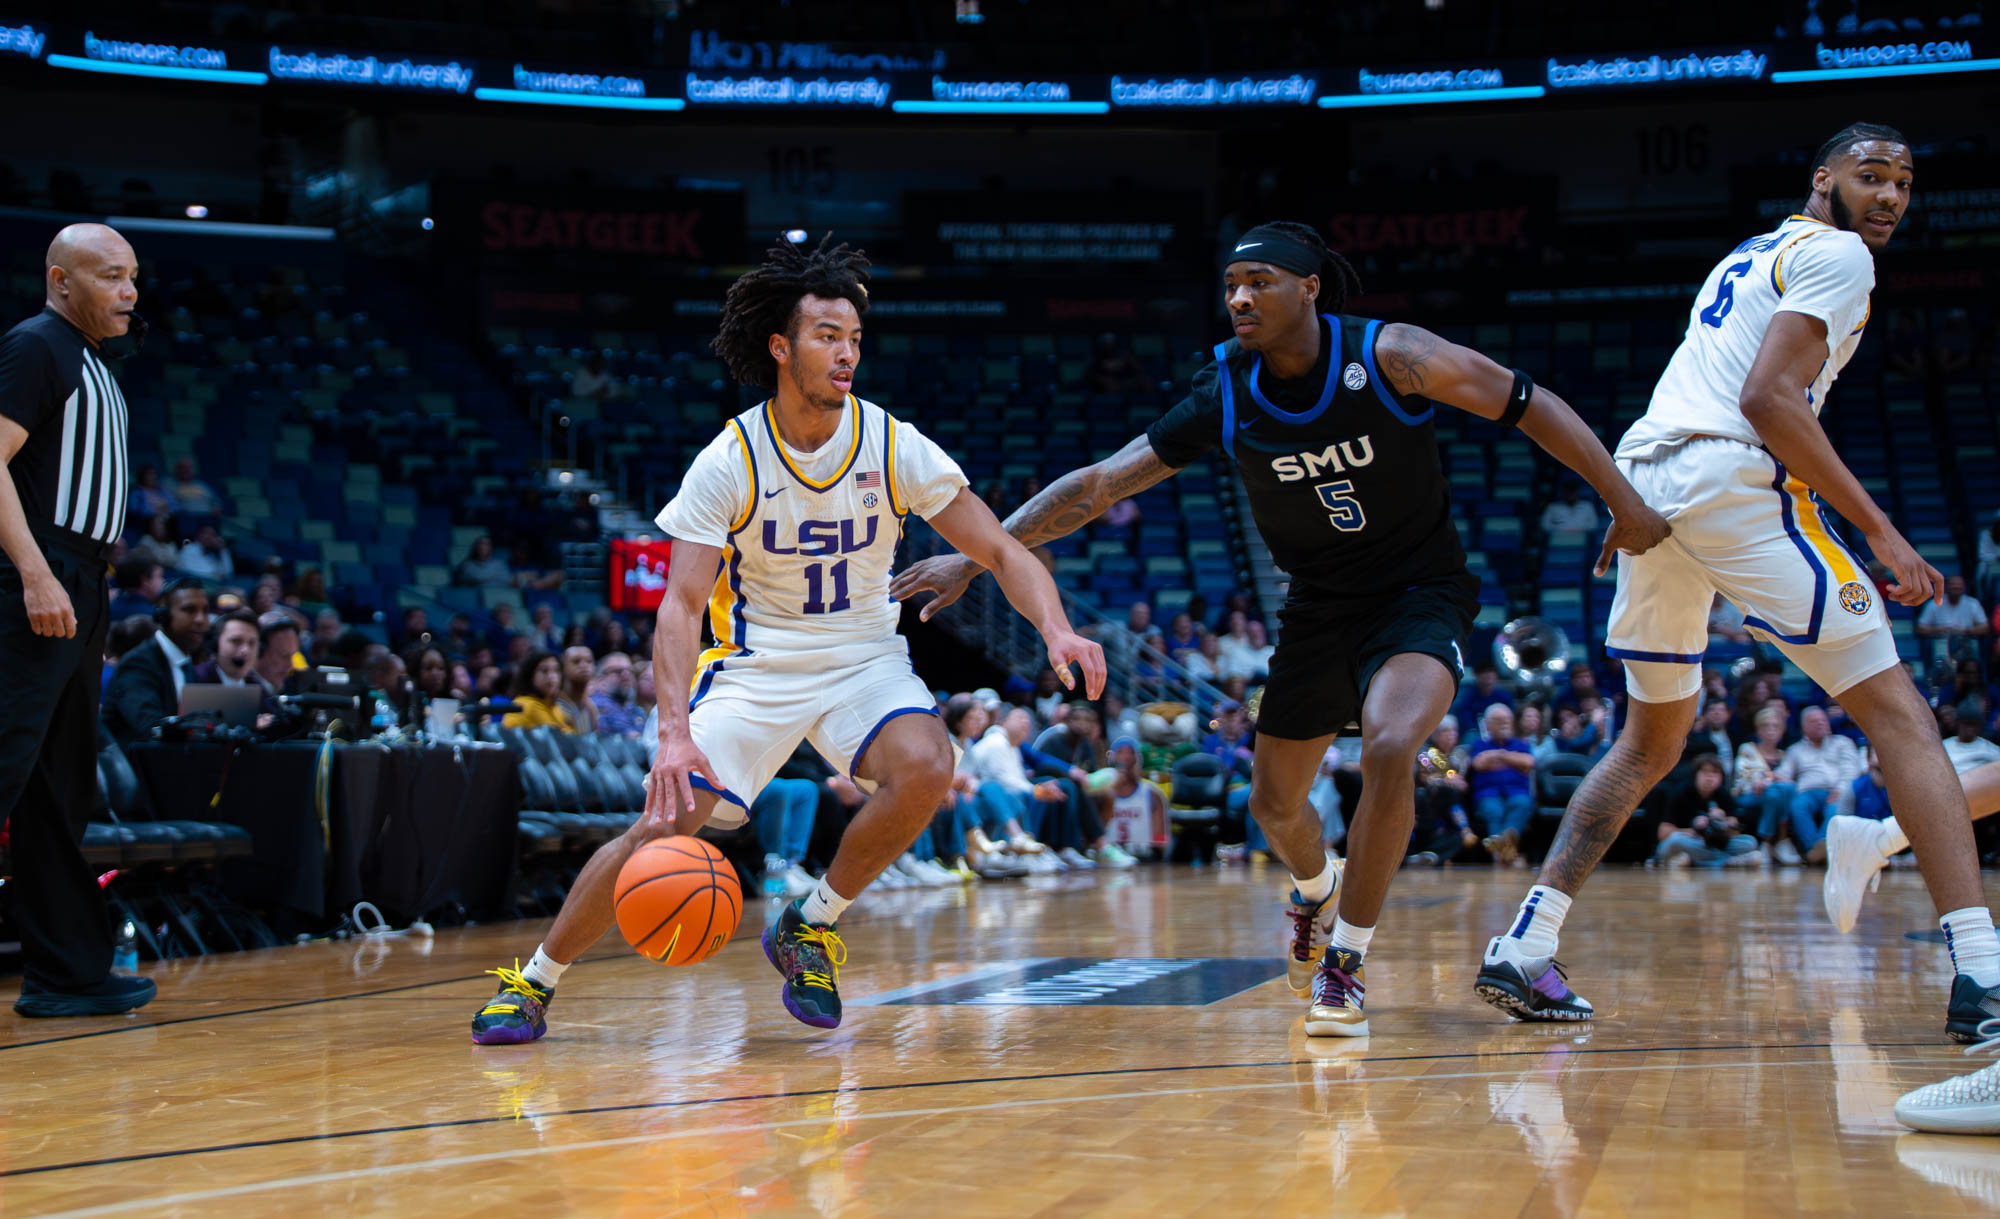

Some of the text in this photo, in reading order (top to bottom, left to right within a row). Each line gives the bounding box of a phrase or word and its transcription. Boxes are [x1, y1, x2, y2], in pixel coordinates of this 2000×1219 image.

[269, 45, 473, 94] basketball university
[686, 72, 891, 108] basketball university
[1111, 74, 1316, 105] basketball university
[1547, 49, 1768, 87] basketball university
[765, 146, 835, 192] 105
[1633, 124, 1711, 176] 106
[480, 200, 704, 259] SEATGEEK
[1327, 204, 1528, 253] SEATGEEK
[1700, 258, 1753, 328] 6
[1271, 434, 1375, 483] SMU
[1314, 479, 1367, 532] 5
[763, 515, 879, 556] LSU
[803, 559, 850, 614] 11
